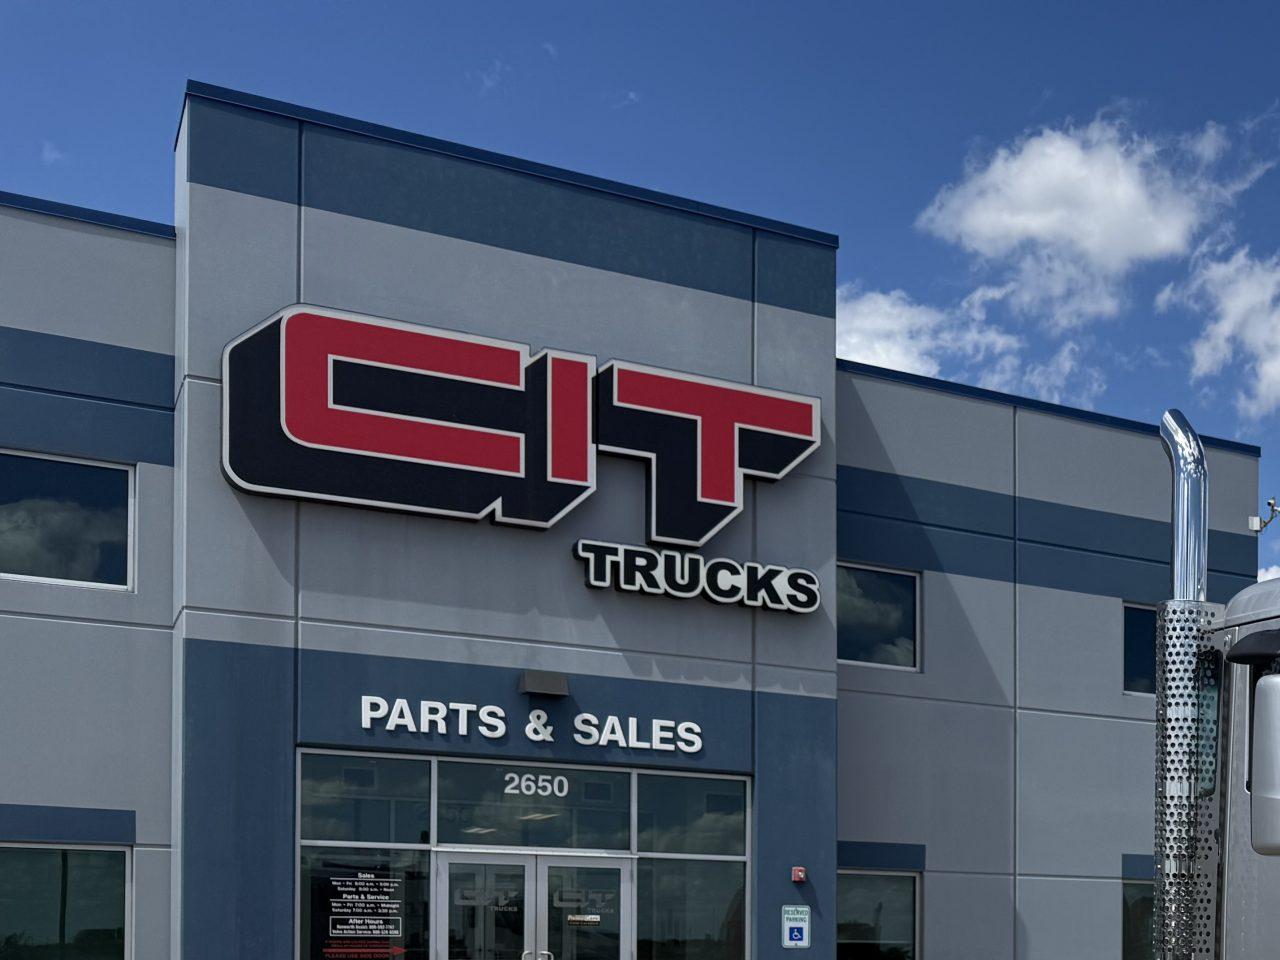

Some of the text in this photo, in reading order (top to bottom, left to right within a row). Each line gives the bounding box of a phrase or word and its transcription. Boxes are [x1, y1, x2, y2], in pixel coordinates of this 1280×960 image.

[222, 304, 820, 546] CIT
[576, 539, 820, 613] TRUCKS
[361, 695, 703, 754] PARTS & SALES
[503, 772, 570, 799] 2650
